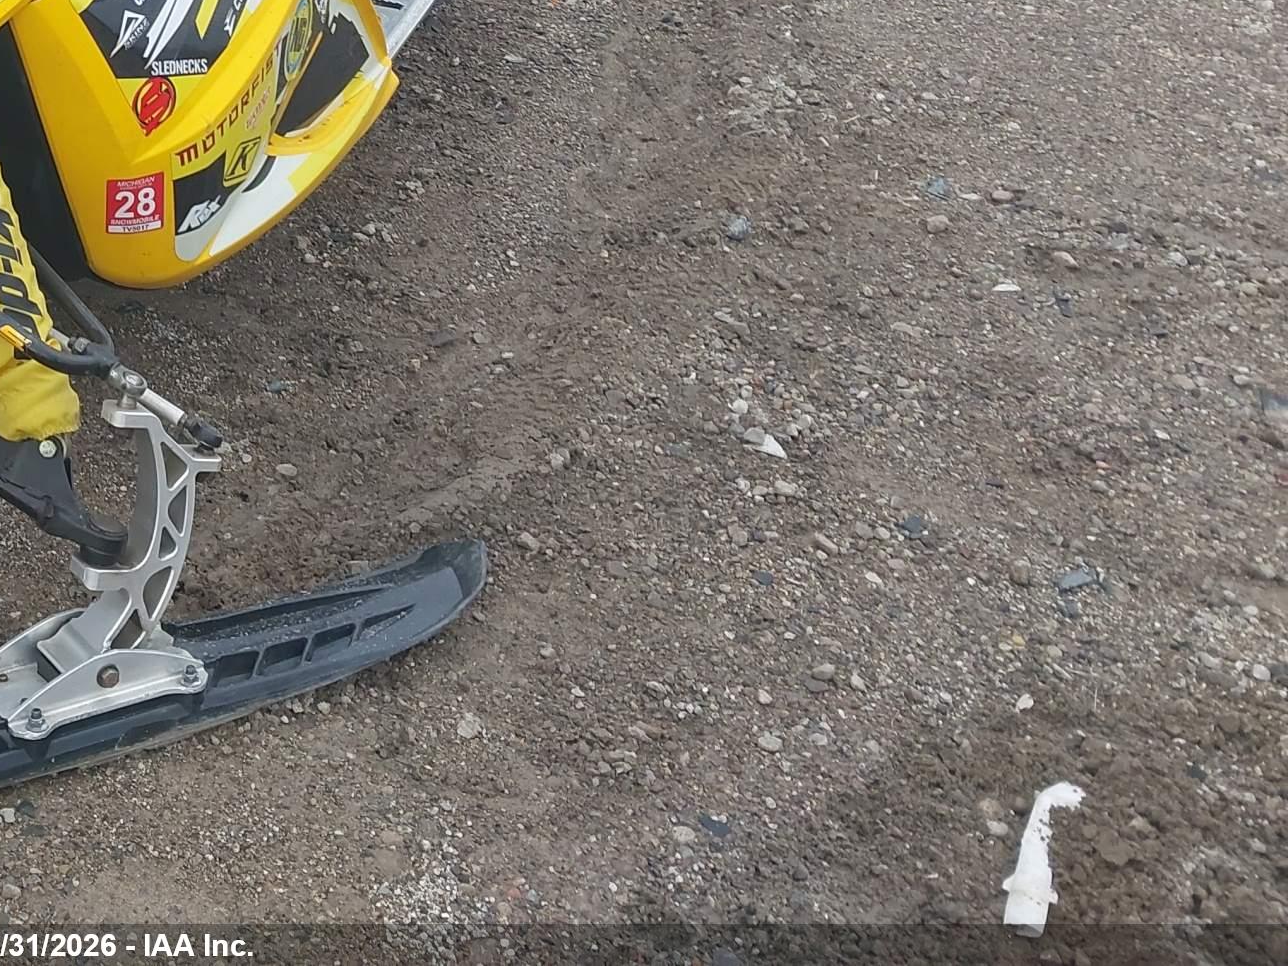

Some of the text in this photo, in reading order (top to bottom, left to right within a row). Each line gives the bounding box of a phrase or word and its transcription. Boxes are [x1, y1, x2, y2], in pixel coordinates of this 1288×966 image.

[151, 58, 208, 76] SLEDNECKS
[117, 176, 155, 187] MICHIGAN
[114, 186, 156, 219] 28
[110, 214, 160, 226] SNOWMOBILE
